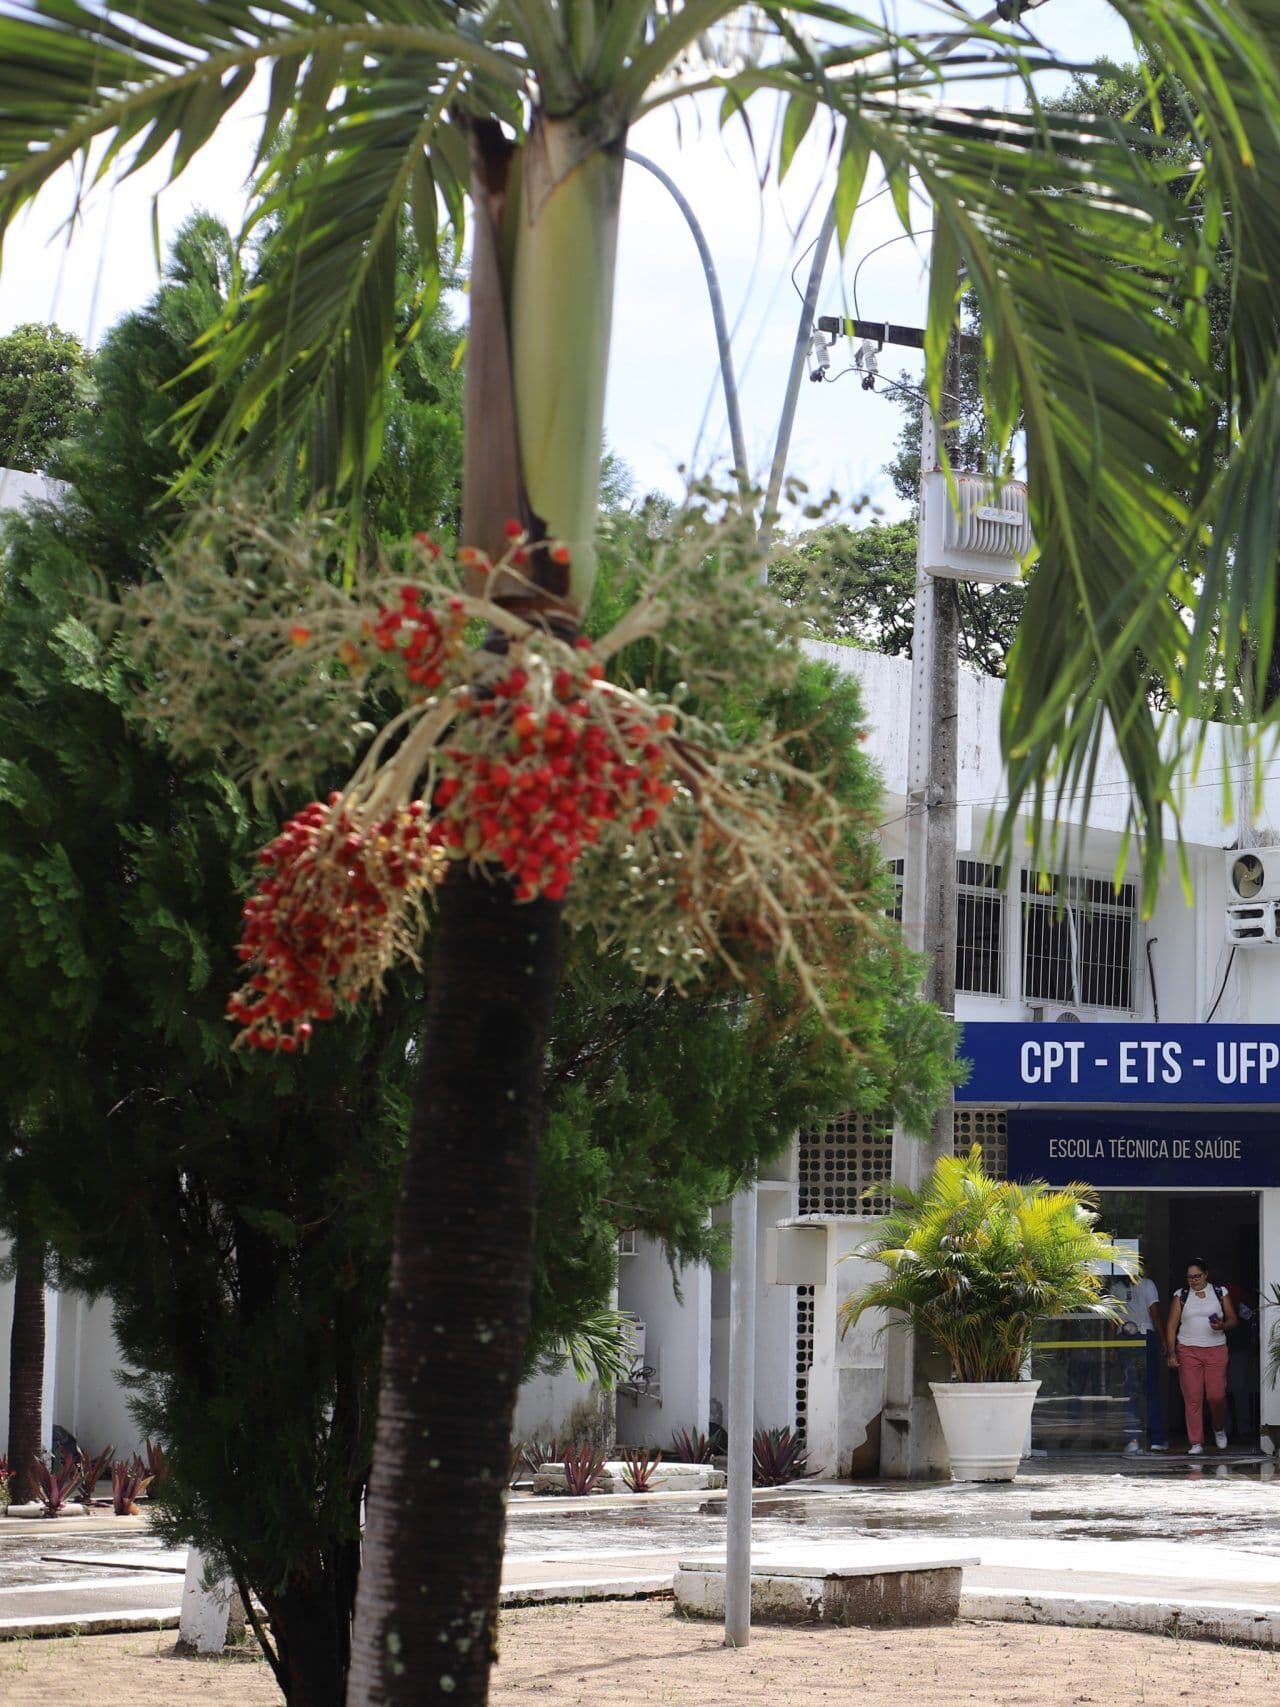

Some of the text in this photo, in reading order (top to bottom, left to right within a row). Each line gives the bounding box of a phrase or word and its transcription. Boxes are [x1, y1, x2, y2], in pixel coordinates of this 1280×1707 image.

[1021, 1041, 1085, 1083] CPT
[1119, 1041, 1182, 1084] ETS
[1049, 1136, 1242, 1159] ESCOLA TÉCNICA DE SAÚDE
